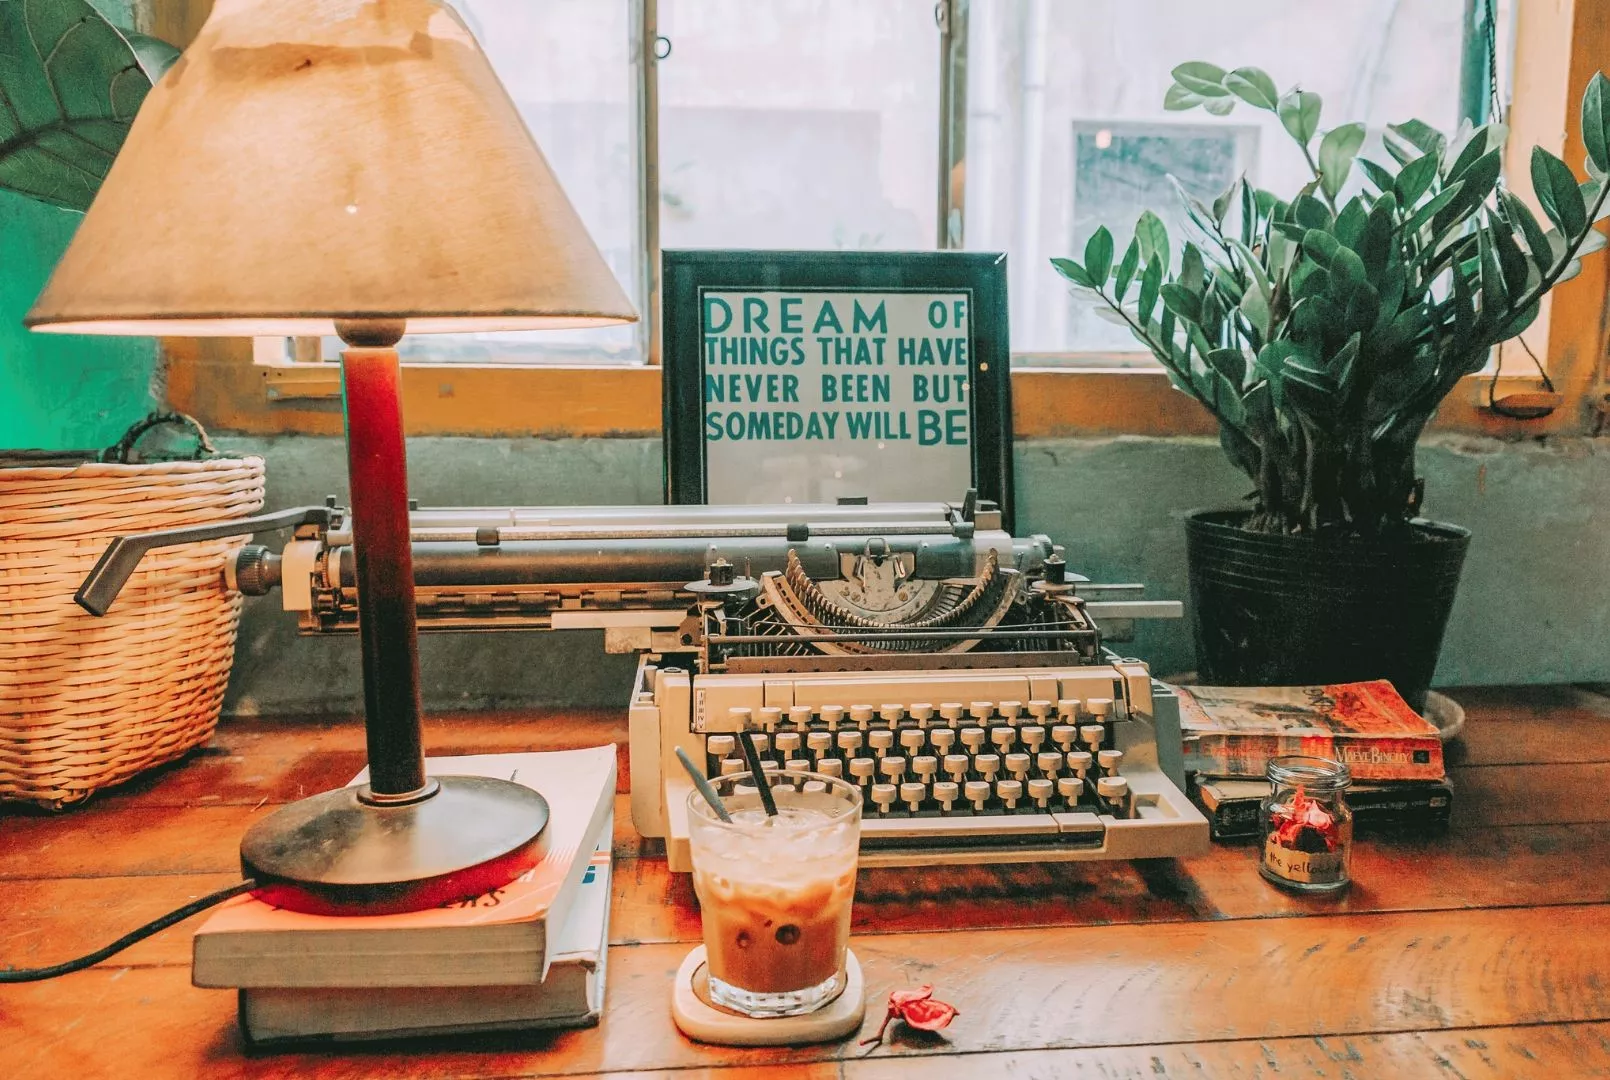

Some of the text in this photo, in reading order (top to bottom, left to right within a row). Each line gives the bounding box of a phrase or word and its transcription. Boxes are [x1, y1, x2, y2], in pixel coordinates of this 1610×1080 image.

[705, 297, 966, 334] DREAM OF
[705, 336, 967, 366] THINGS THAT HAVE
[705, 374, 967, 404] NEVER BEEN BUT
[706, 409, 968, 446] SOMEDAY WILL BE
[1371, 746, 1410, 764] BINCHY
